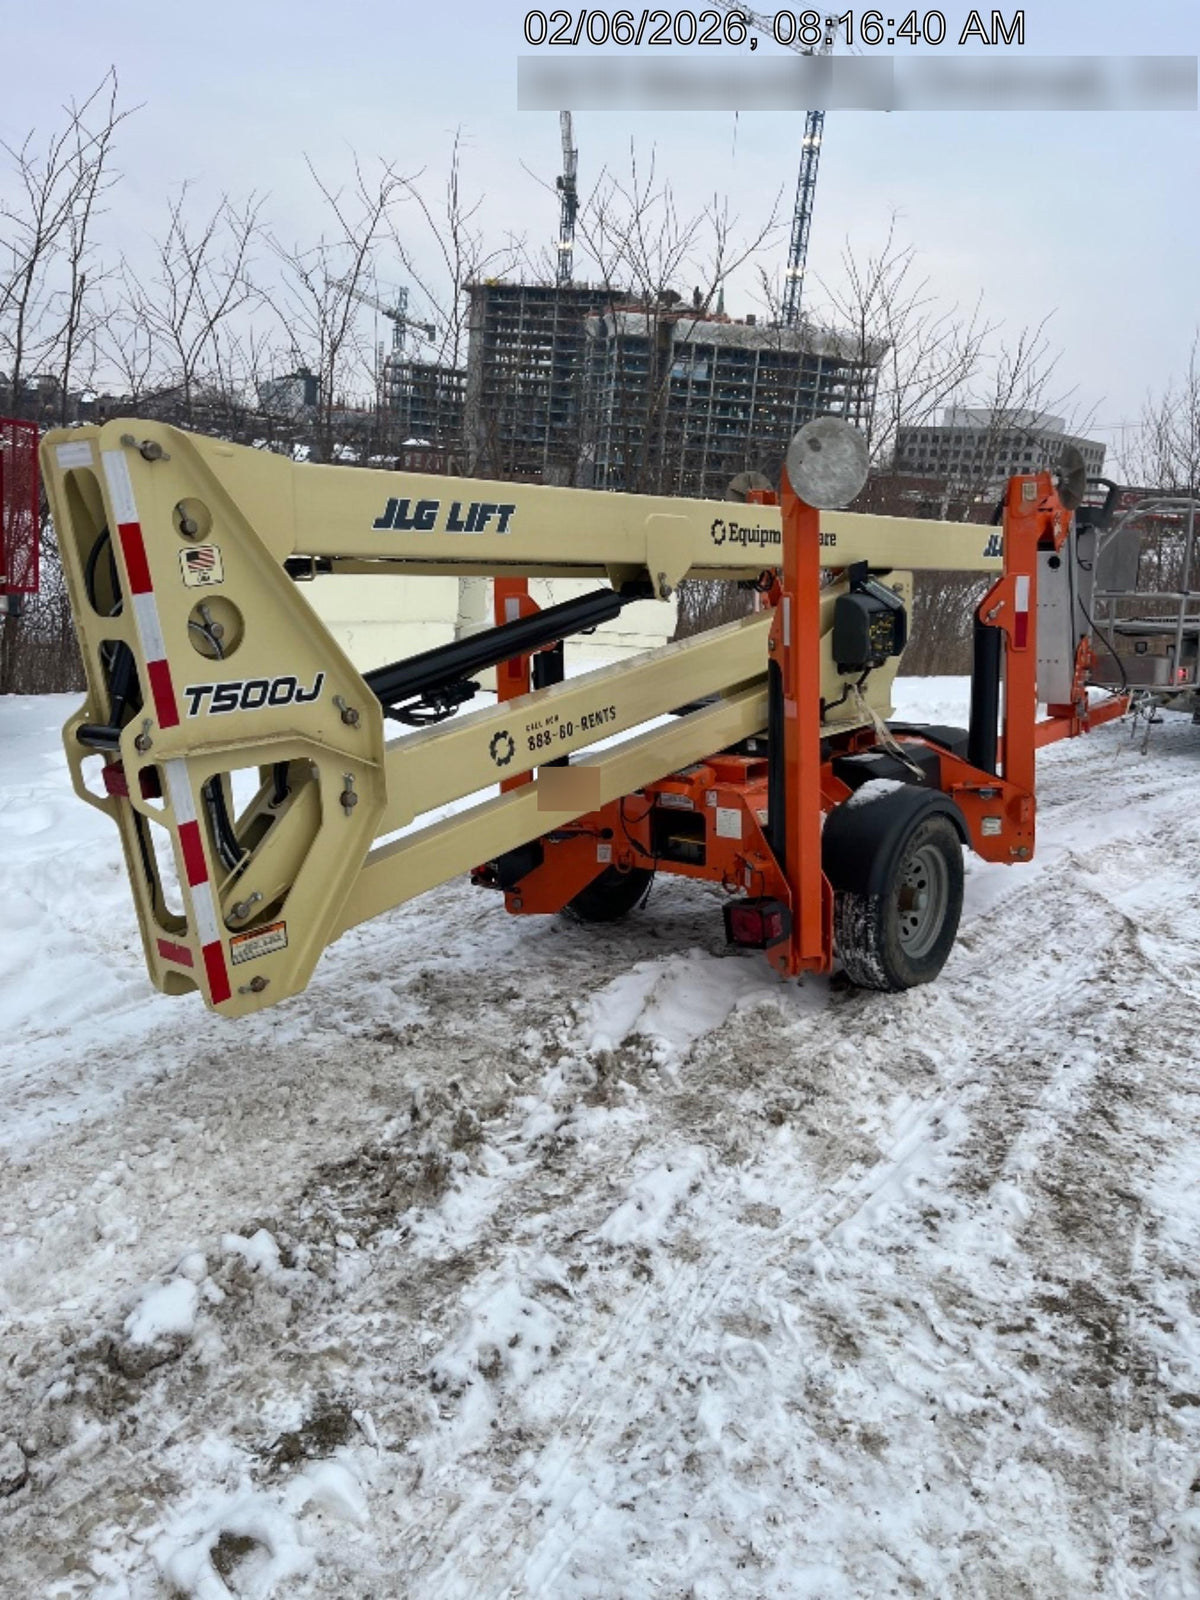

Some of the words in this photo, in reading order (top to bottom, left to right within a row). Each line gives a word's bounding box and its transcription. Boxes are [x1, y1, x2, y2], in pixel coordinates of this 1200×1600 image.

[371, 497, 440, 532] JLG
[445, 501, 517, 534] LIFT
[184, 671, 326, 718] T500J
